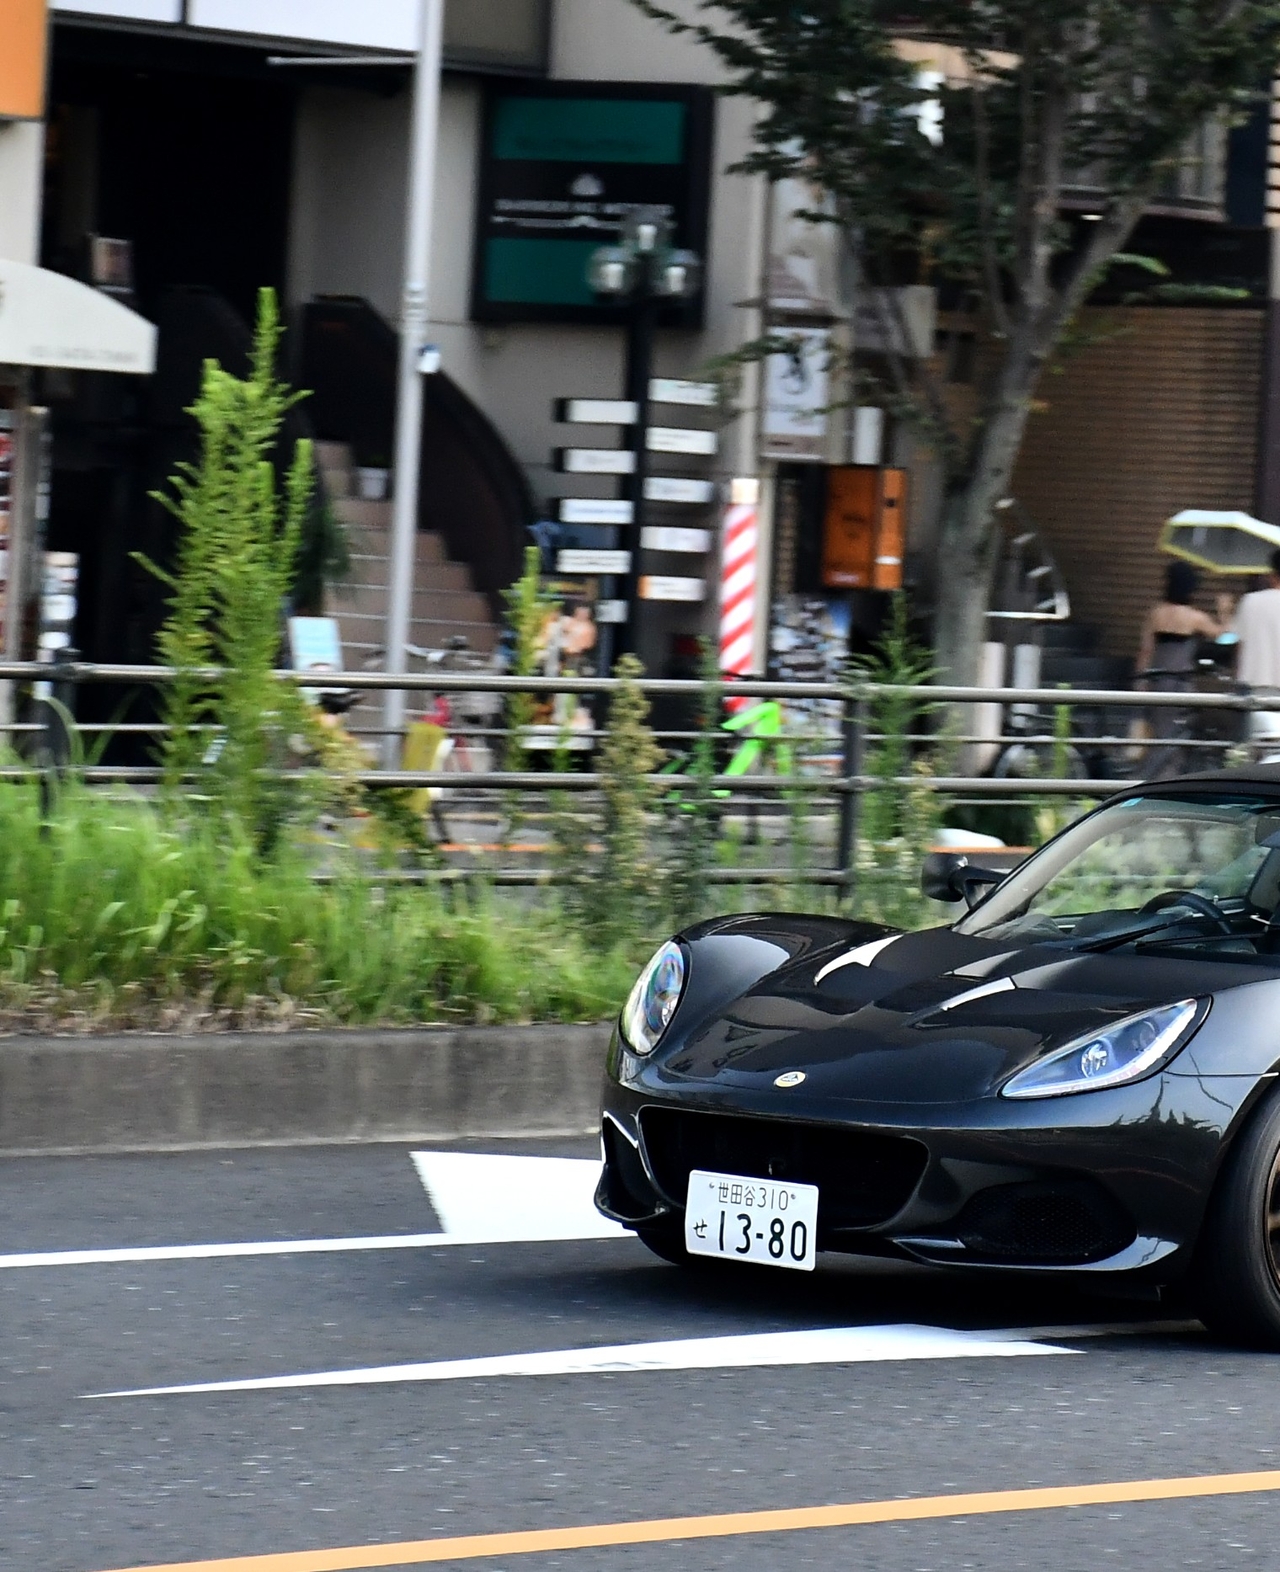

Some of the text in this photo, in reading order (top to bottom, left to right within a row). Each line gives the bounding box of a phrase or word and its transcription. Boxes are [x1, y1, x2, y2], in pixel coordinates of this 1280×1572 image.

[718, 1181, 789, 1211] 世田谷310
[693, 1210, 807, 1262] せ 13-80
